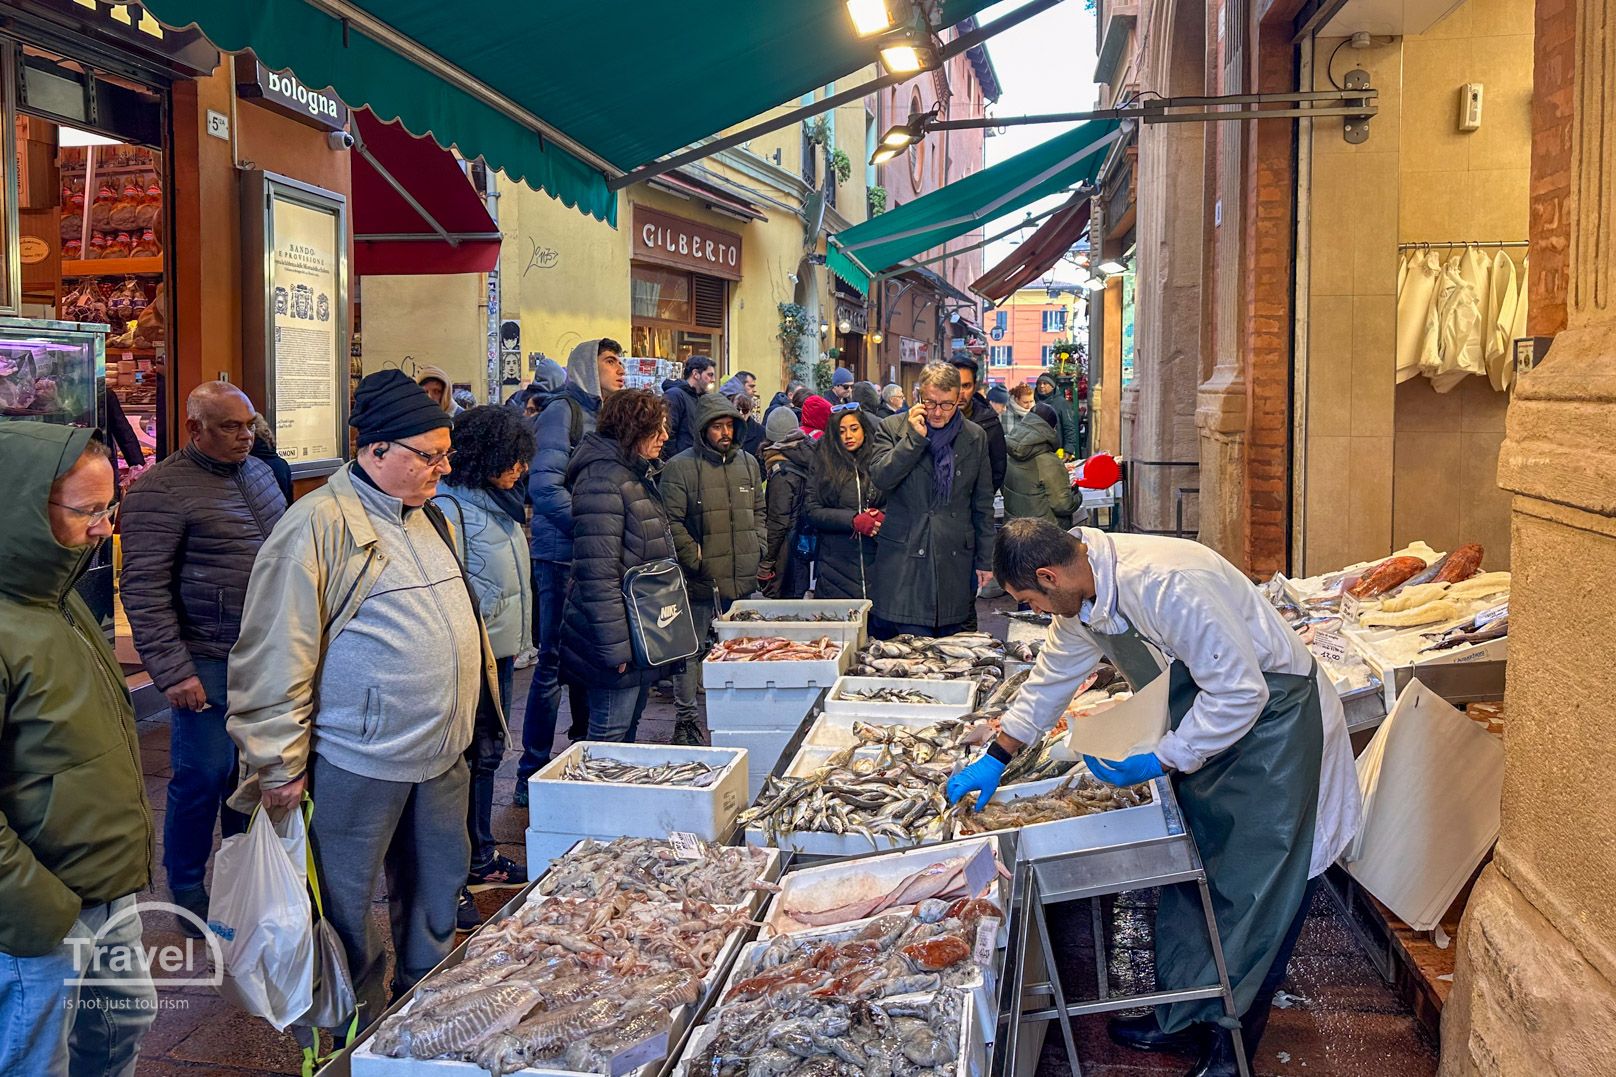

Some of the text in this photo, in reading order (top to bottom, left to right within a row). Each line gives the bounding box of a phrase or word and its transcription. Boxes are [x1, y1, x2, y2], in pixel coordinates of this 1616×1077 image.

[268, 72, 338, 118] Bologna
[642, 223, 737, 266] GILBERTO
[660, 603, 678, 620] NIKE
